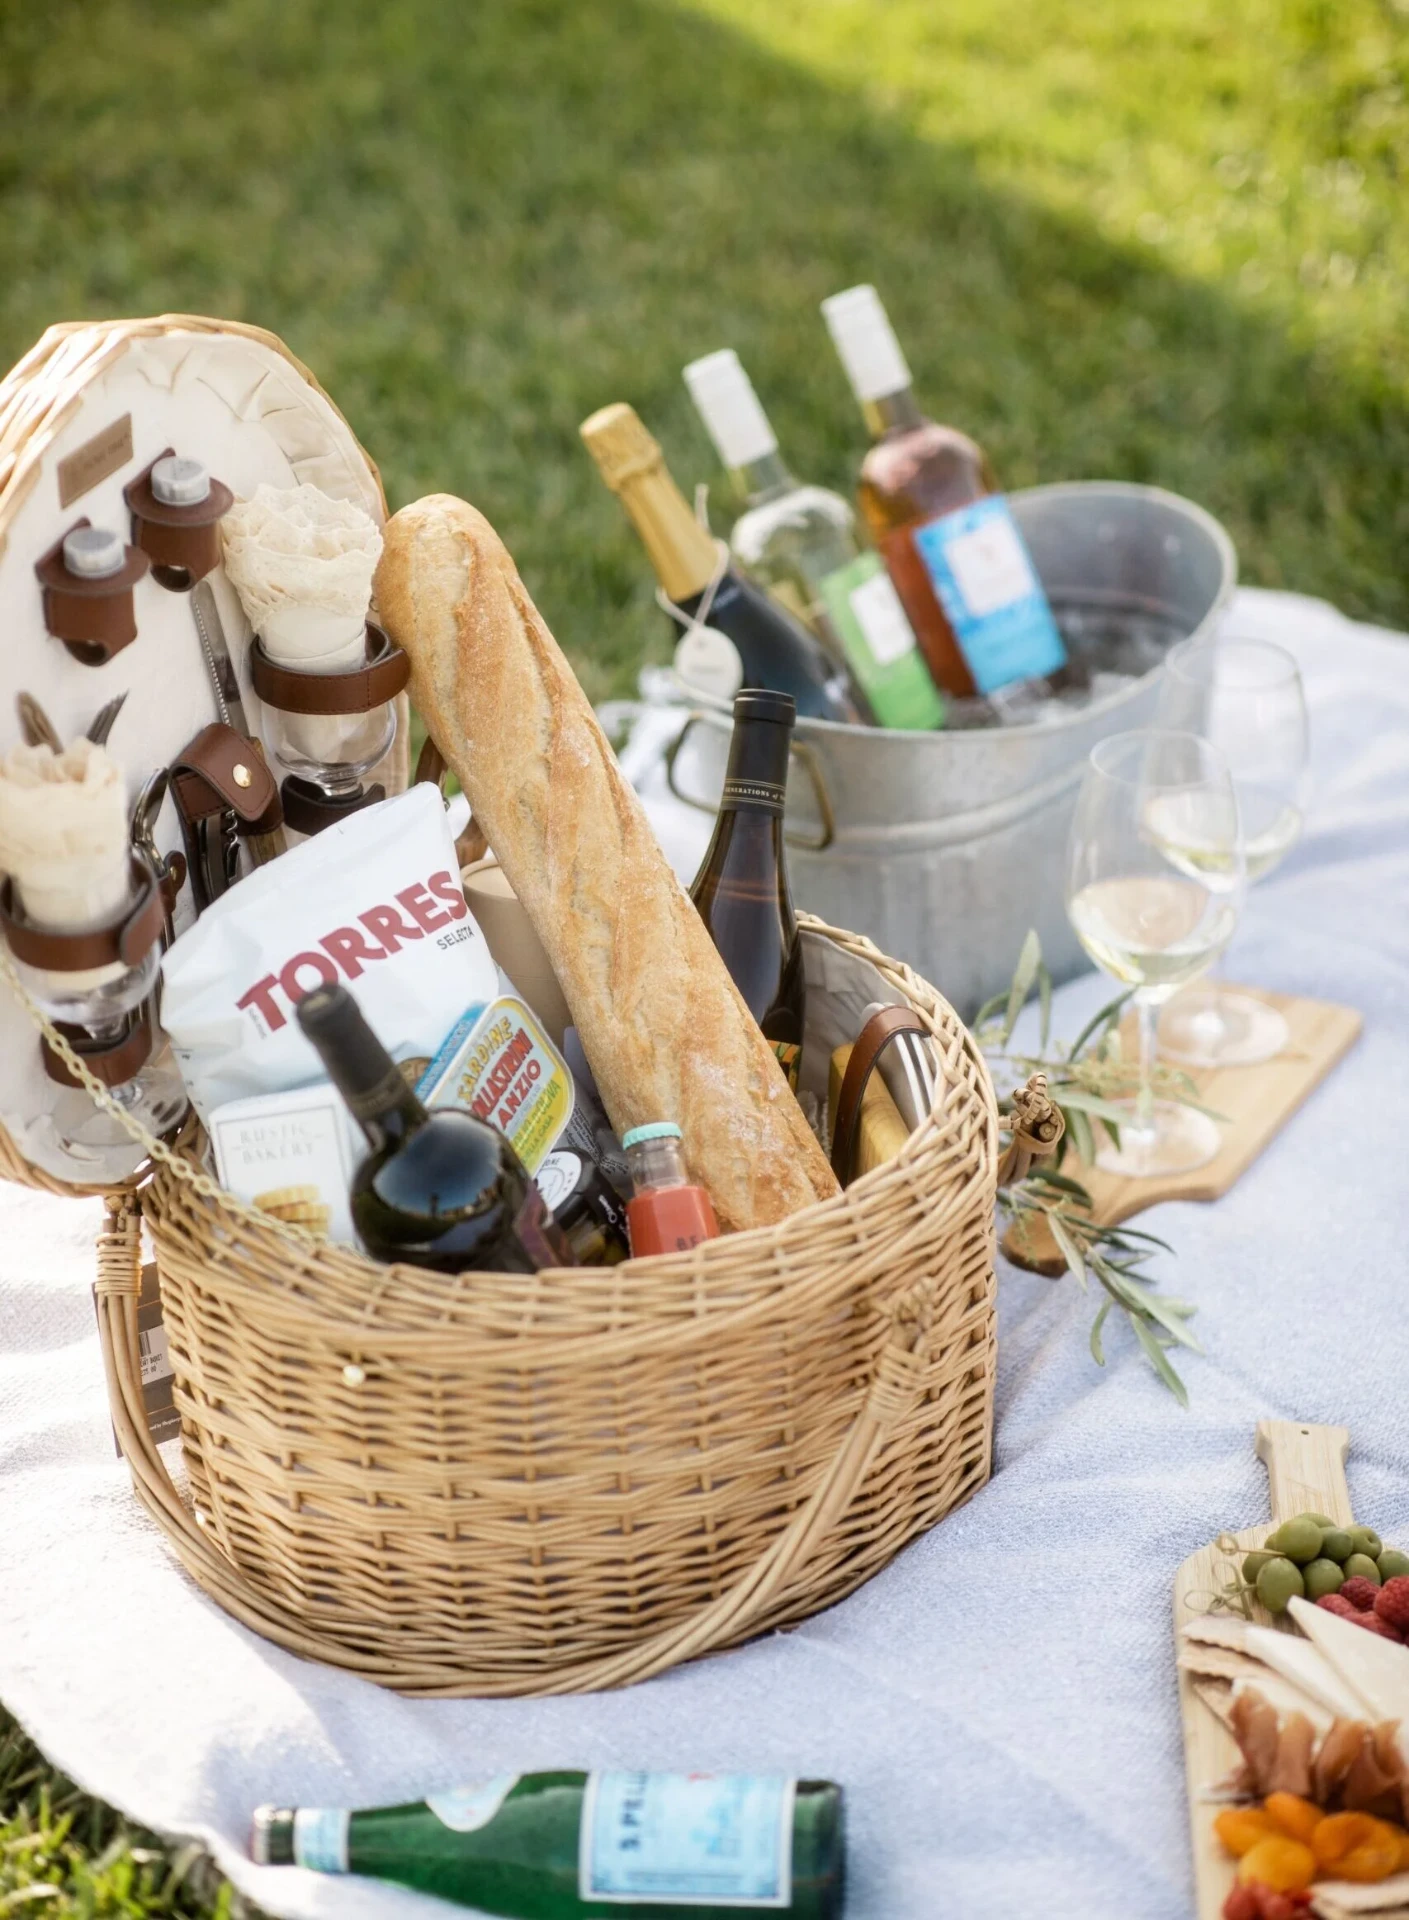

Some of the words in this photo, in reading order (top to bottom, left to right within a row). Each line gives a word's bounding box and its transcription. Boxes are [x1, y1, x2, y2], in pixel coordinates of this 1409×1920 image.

[235, 870, 468, 1032] TORRES
[436, 925, 475, 951] SELECTA
[457, 1016, 514, 1104] SARDINE
[498, 1059, 541, 1130] ANZIO
